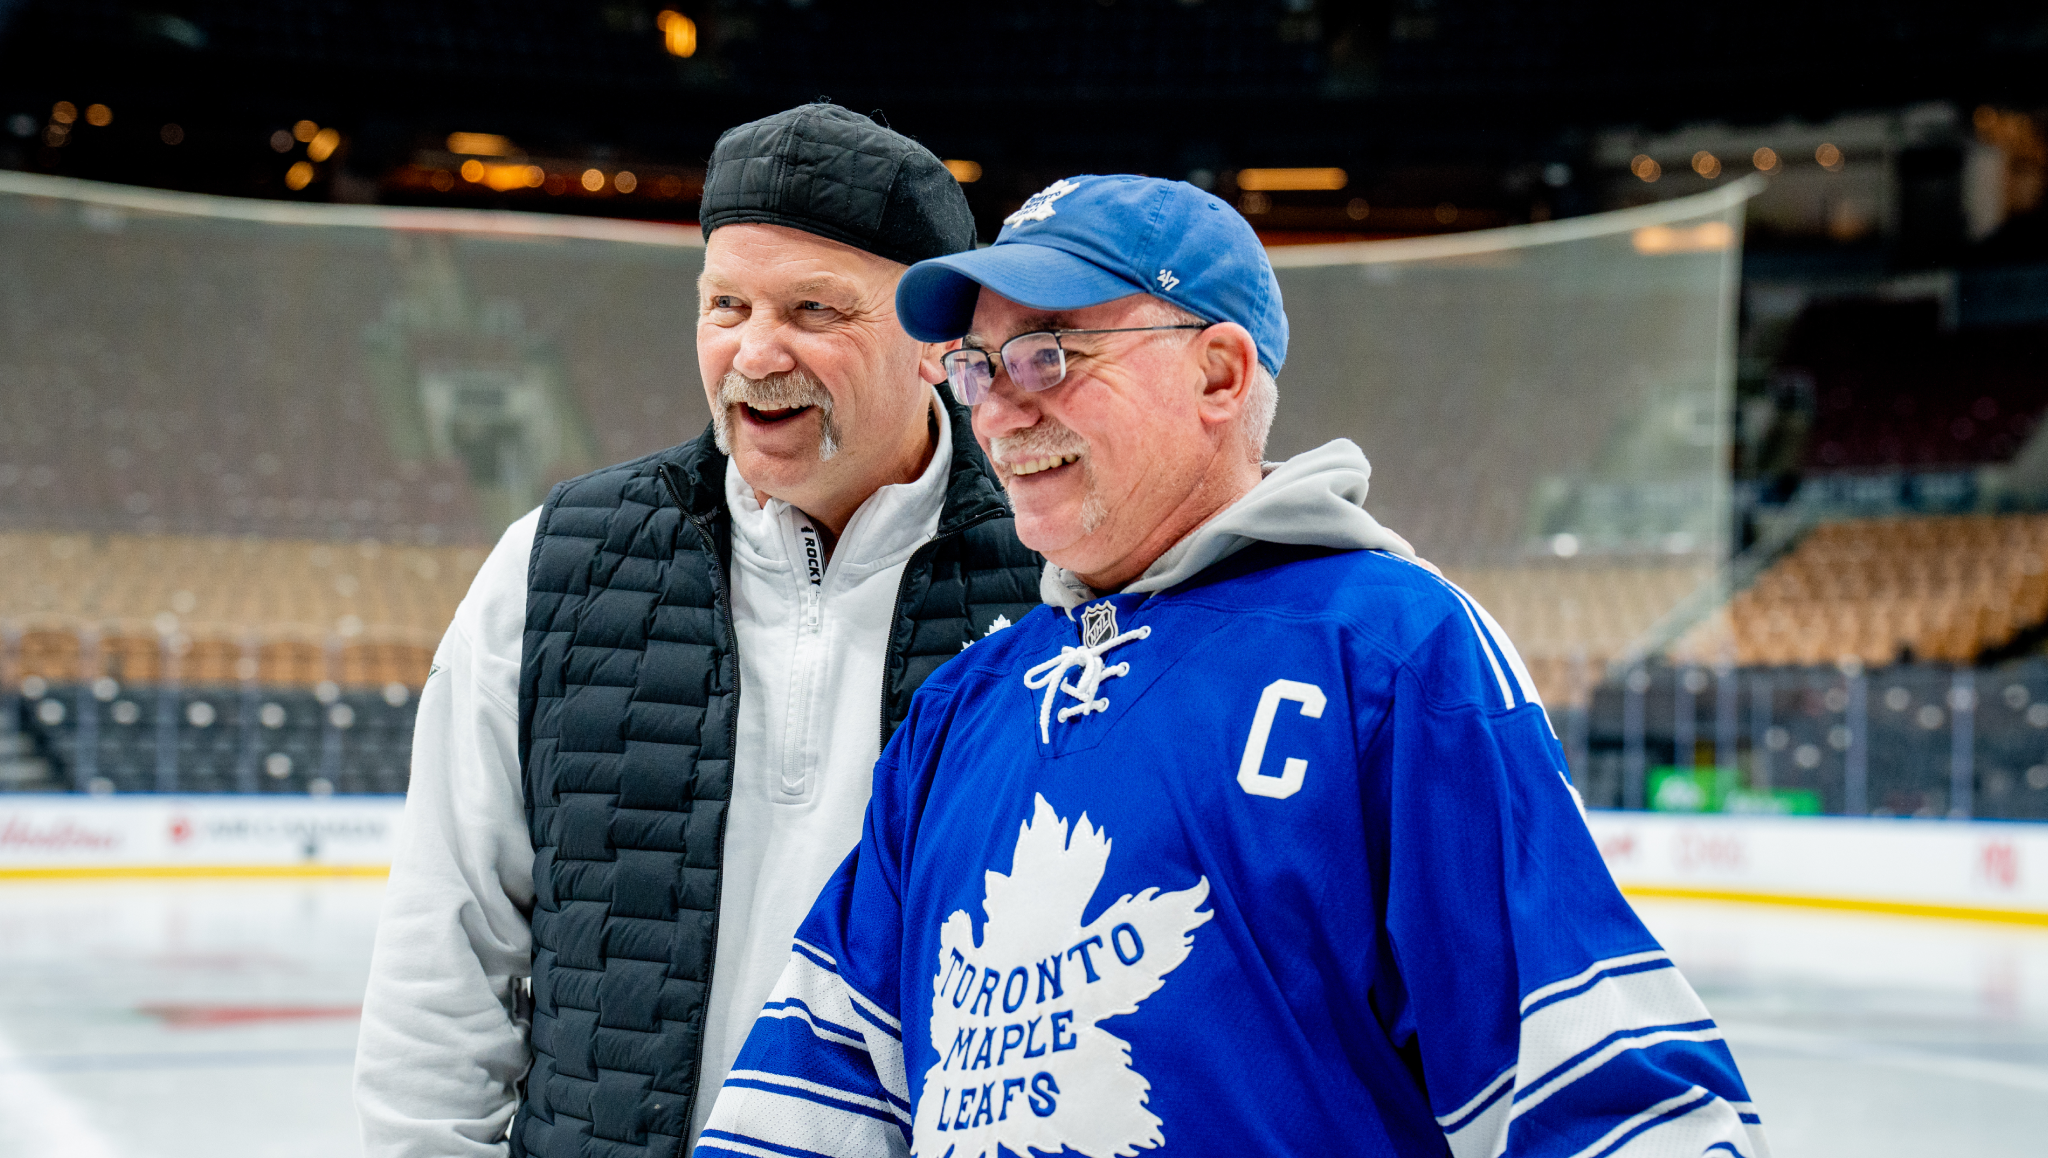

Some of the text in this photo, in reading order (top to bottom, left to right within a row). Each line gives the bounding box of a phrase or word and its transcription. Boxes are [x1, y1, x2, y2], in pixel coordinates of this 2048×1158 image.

[804, 537, 821, 586] ROCKY
[1089, 613, 1109, 646] NHL
[1237, 679, 1327, 800] C
[940, 922, 1144, 1017] TORONTO
[942, 1009, 1077, 1071] MAPLE
[937, 1071, 1060, 1132] LEAFS
